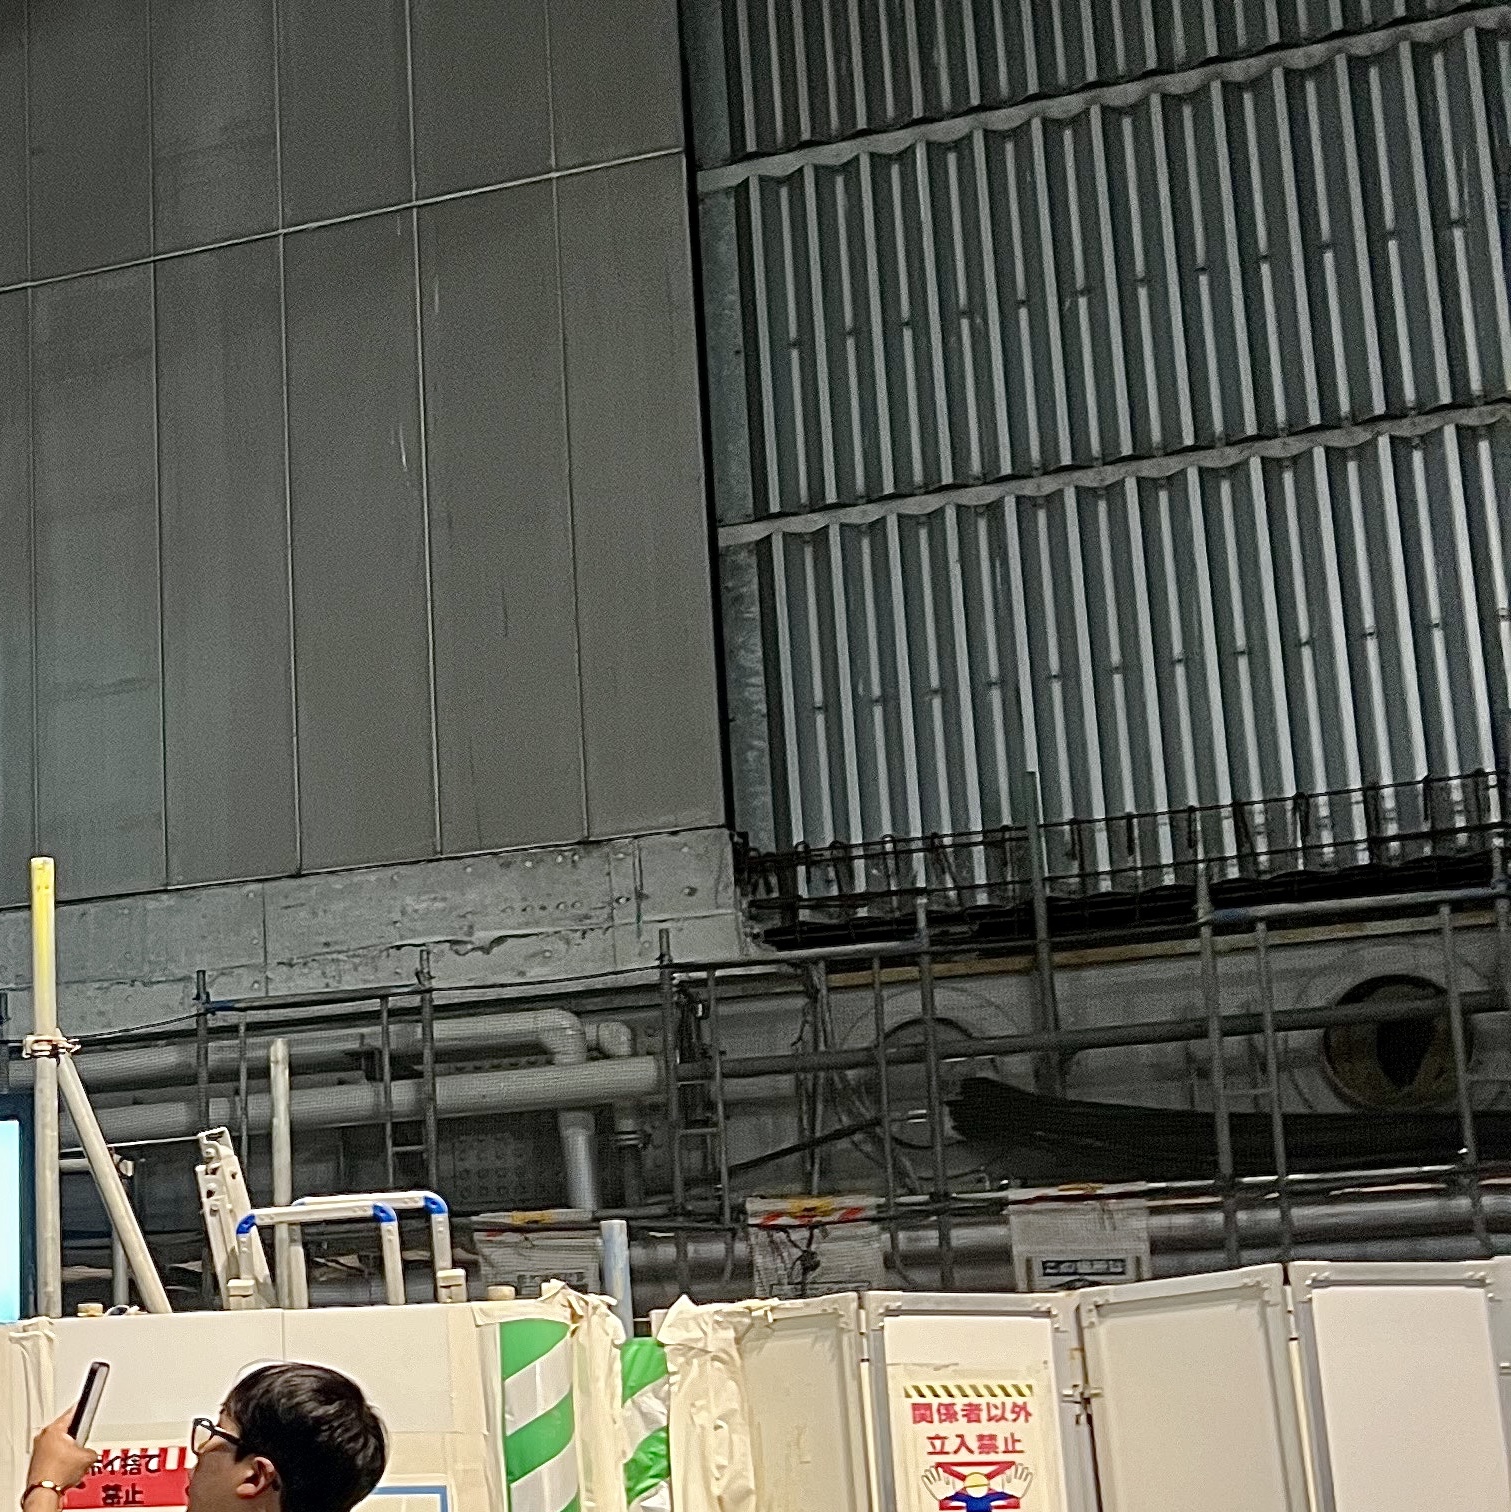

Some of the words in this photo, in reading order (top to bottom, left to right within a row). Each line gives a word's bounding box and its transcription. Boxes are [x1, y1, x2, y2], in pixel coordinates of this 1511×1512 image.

[910, 1401, 1033, 1425] 関係者以外
[926, 1431, 1026, 1456] 立入禁止
[101, 1482, 145, 1507] 禁止
